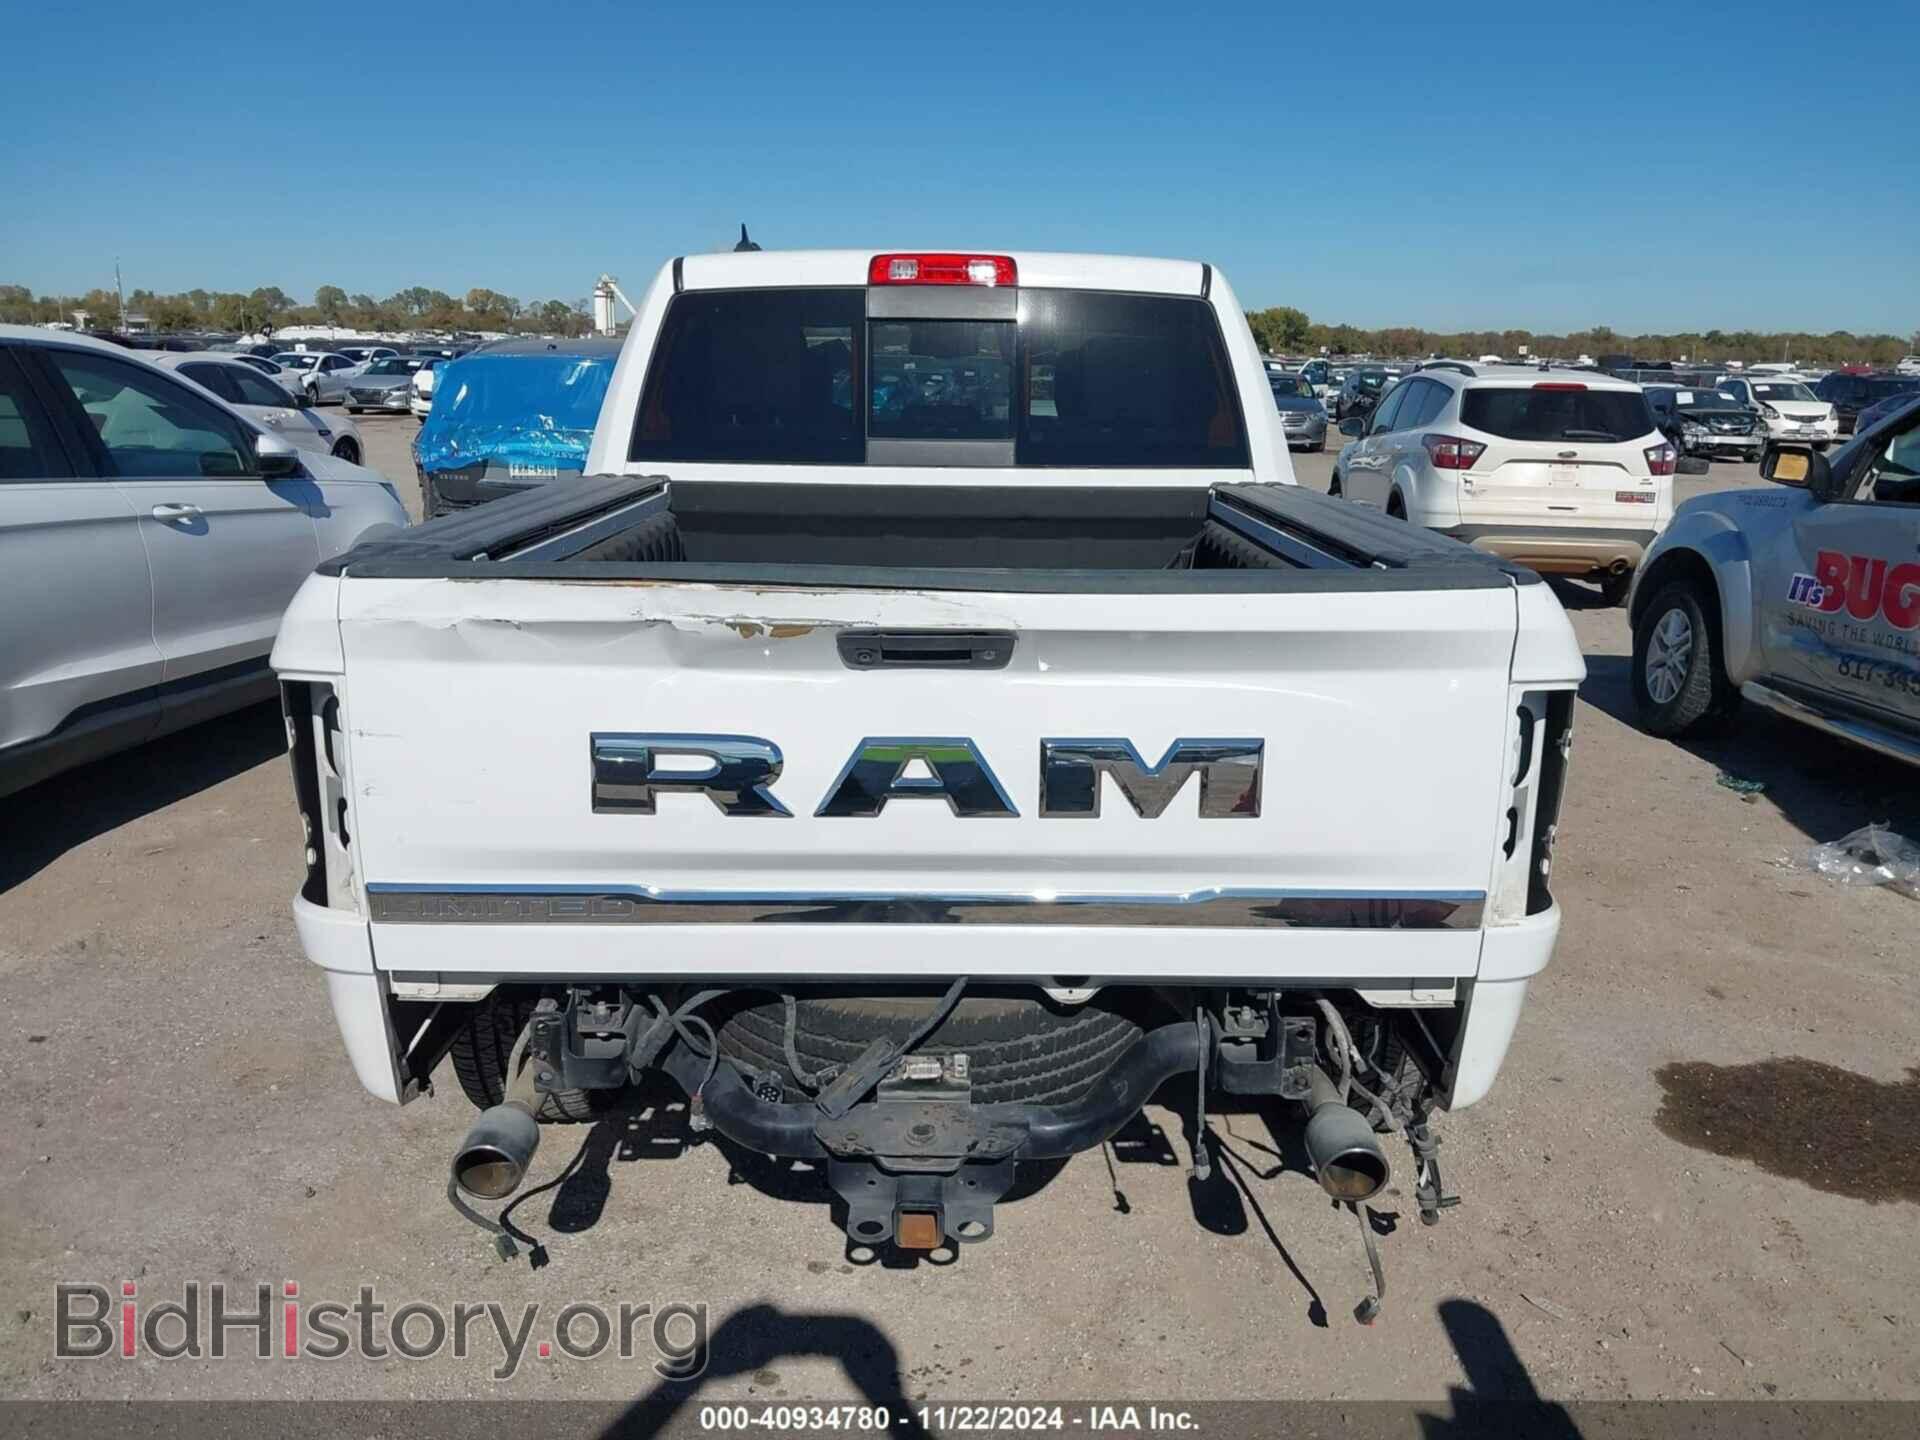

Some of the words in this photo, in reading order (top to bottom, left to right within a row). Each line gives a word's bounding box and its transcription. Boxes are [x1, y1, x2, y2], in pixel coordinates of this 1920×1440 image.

[1787, 612, 1835, 637] SAVING
[1843, 623, 1869, 643] THE
[1872, 630, 1920, 656] WORL
[590, 731, 1265, 819] RAM
[378, 895, 636, 918] LIMITED
